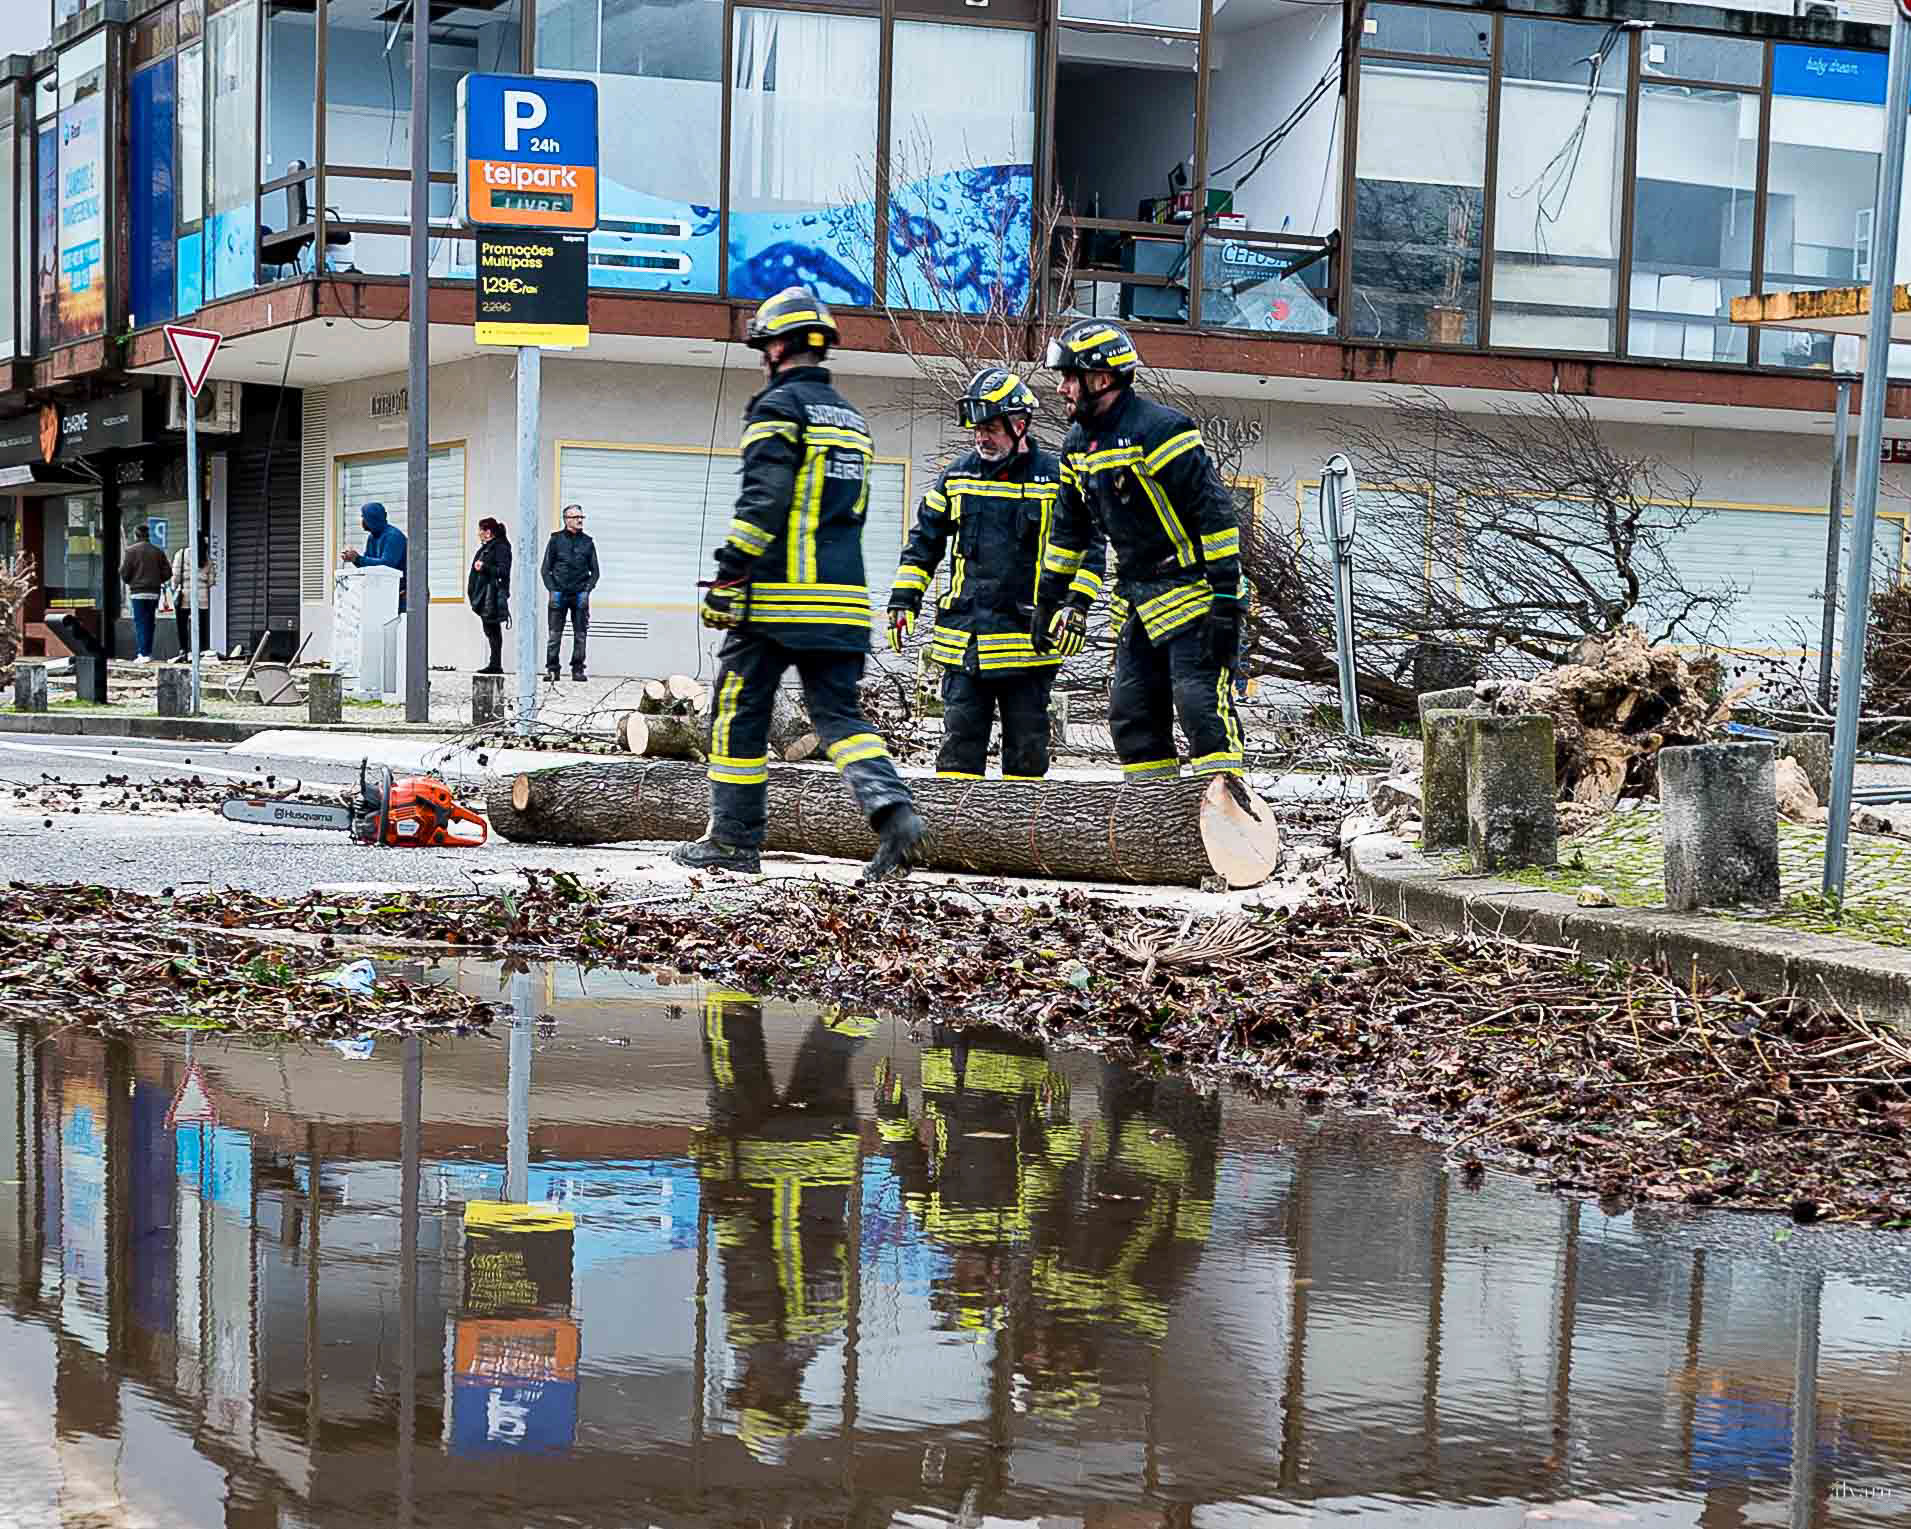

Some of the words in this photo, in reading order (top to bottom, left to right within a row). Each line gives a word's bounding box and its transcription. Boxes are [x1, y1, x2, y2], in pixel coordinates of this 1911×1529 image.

[504, 90, 547, 151] P
[530, 137, 560, 153] 24h
[484, 163, 577, 190] telpark
[482, 243, 554, 258] Promoções
[482, 256, 543, 270] Multipass
[285, 810, 333, 823] Husqvarna
